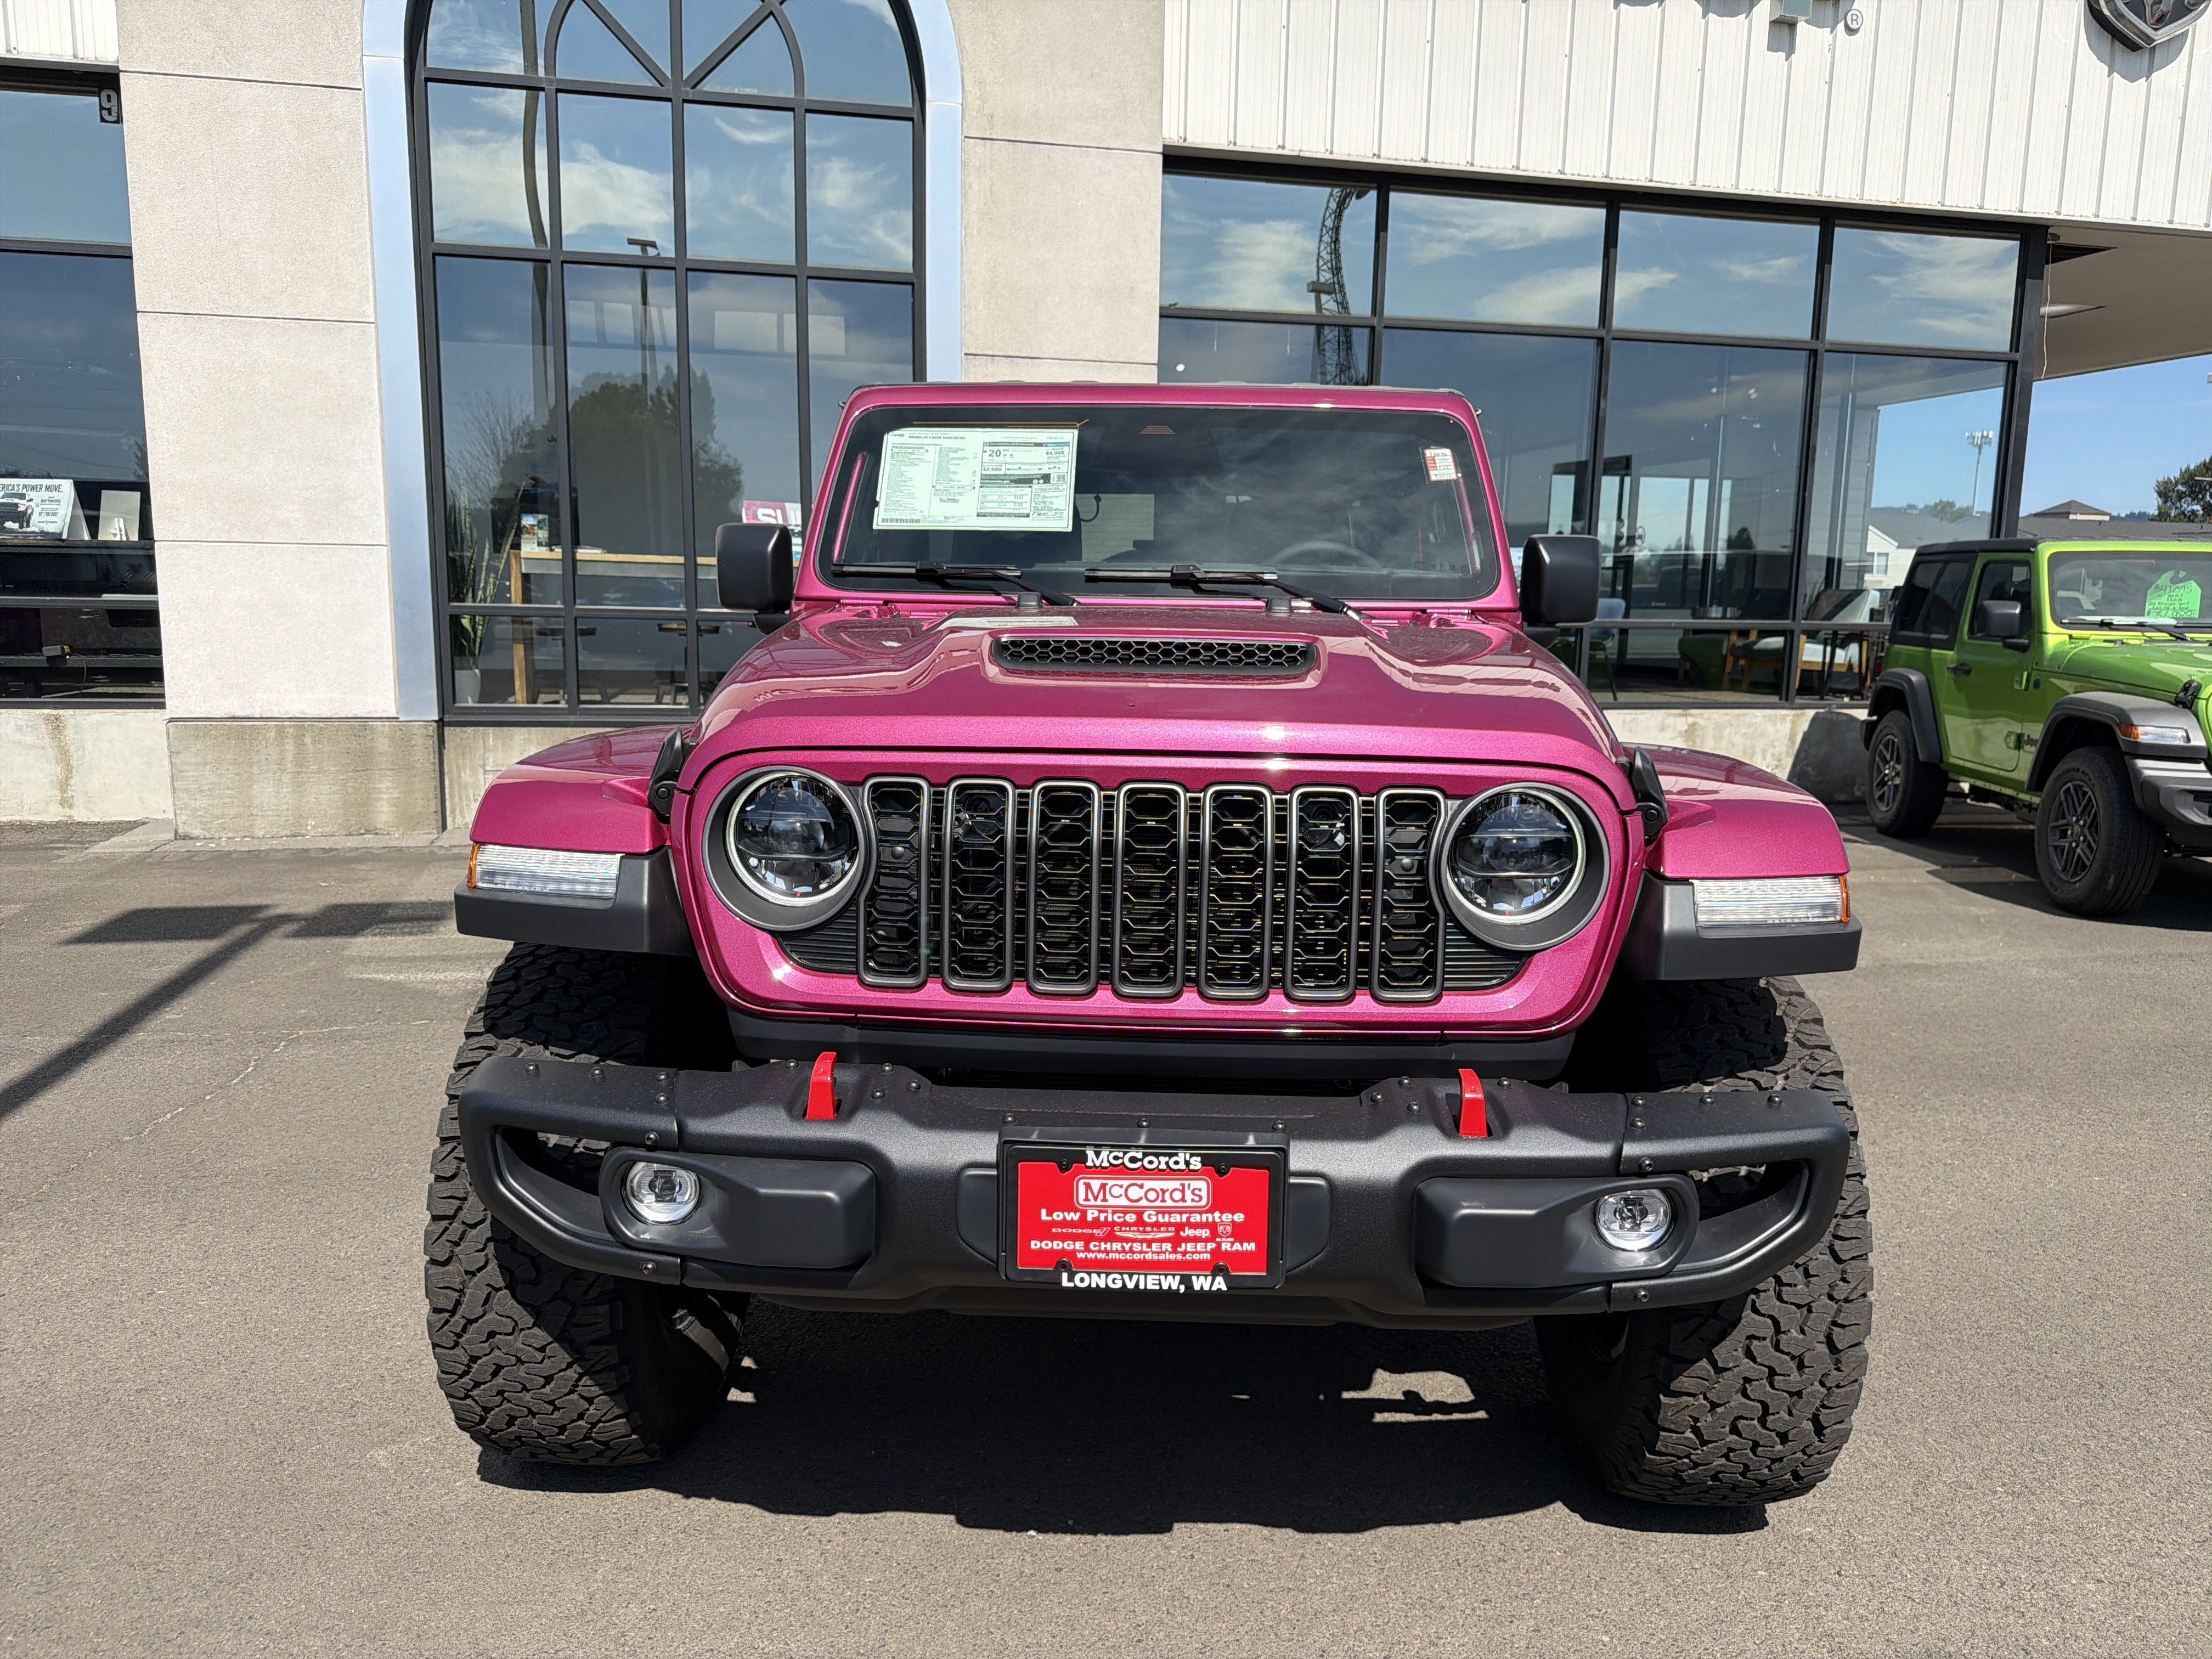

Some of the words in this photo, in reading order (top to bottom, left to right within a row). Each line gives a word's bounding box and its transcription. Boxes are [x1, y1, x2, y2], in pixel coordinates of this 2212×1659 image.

[100, 88, 118, 122] 9
[989, 449, 1001, 457] 20
[21, 484, 43, 493] POWER
[44, 484, 64, 493] MOVE.
[1086, 1150, 1202, 1170] McCord's
[1082, 1182, 1203, 1203] McCord's
[1041, 1208, 1080, 1221] Low
[1087, 1210, 1137, 1222] Price
[1143, 1210, 1245, 1223] Guarantee
[1180, 1226, 1210, 1238] Jeep
[1030, 1240, 1085, 1250] DODGE
[1089, 1241, 1172, 1251] CHRYSLER
[1176, 1242, 1216, 1251] JEEP
[1221, 1242, 1256, 1251] RAM
[1076, 1251, 1211, 1260] www.mccordsales.com
[1062, 1272, 1185, 1293] LONGVIEW,
[1192, 1276, 1227, 1290] WA
